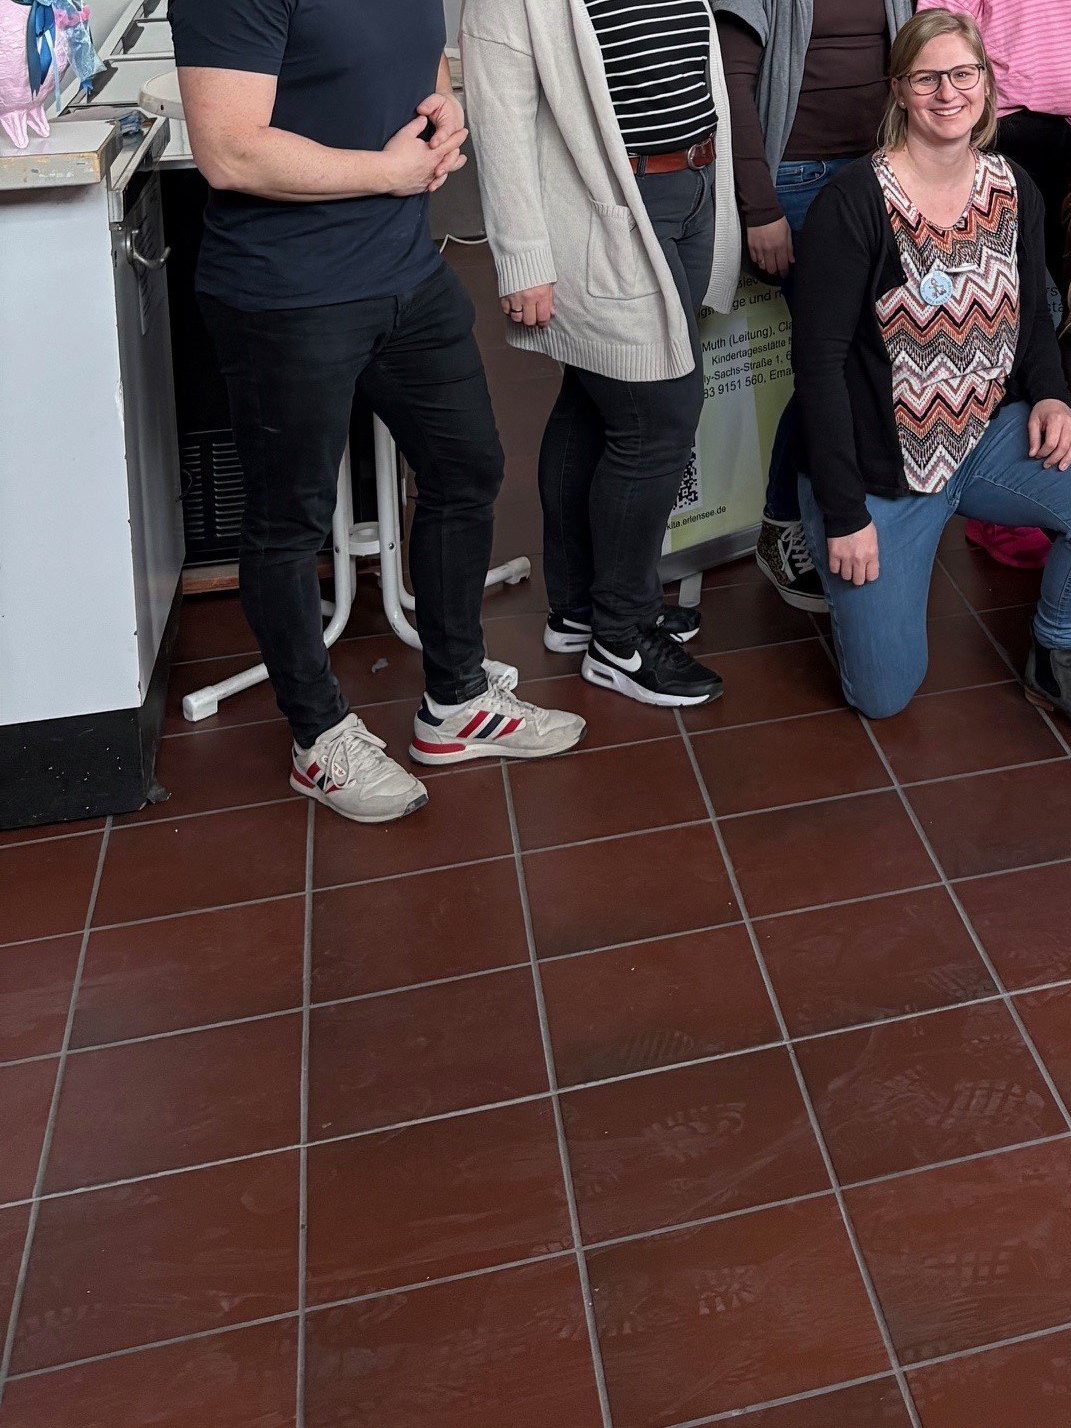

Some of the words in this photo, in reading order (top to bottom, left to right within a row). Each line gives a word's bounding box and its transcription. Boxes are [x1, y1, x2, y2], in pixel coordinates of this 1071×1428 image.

[749, 290, 771, 304] und
[702, 337, 726, 352] Muth
[711, 339, 786, 365] Kindertagesstätte
[718, 379, 741, 394] 9151
